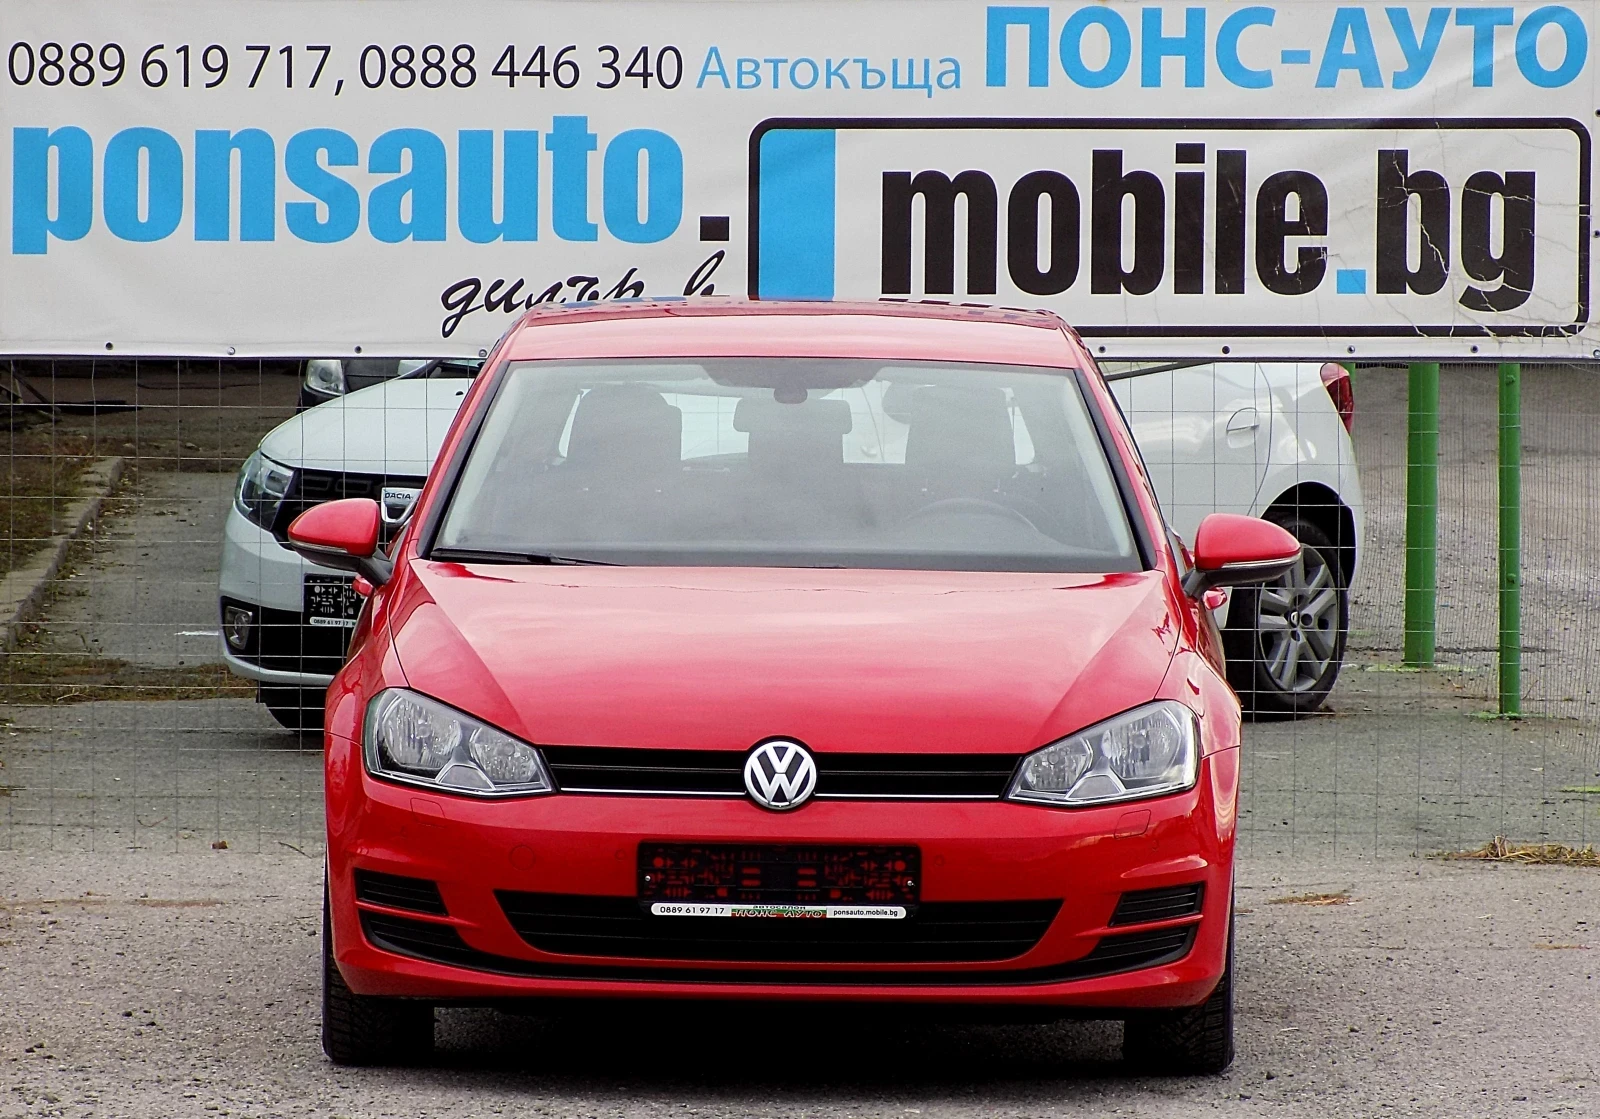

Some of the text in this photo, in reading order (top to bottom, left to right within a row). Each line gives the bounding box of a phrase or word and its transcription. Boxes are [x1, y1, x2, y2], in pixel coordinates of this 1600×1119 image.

[985, 5, 1589, 90] ПОНС-АУТО
[8, 41, 683, 96] 0889 619 717, 0888 446 340
[696, 45, 961, 98] Автокъща
[881, 142, 1537, 313] mobile.bg
[384, 492, 411, 500] DACIA
[659, 906, 683, 914] 0889
[699, 907, 711, 915] 97
[715, 907, 725, 915] 17
[783, 909, 822, 918] АУТО
[833, 909, 899, 917] ponsauto.mobile.bg
